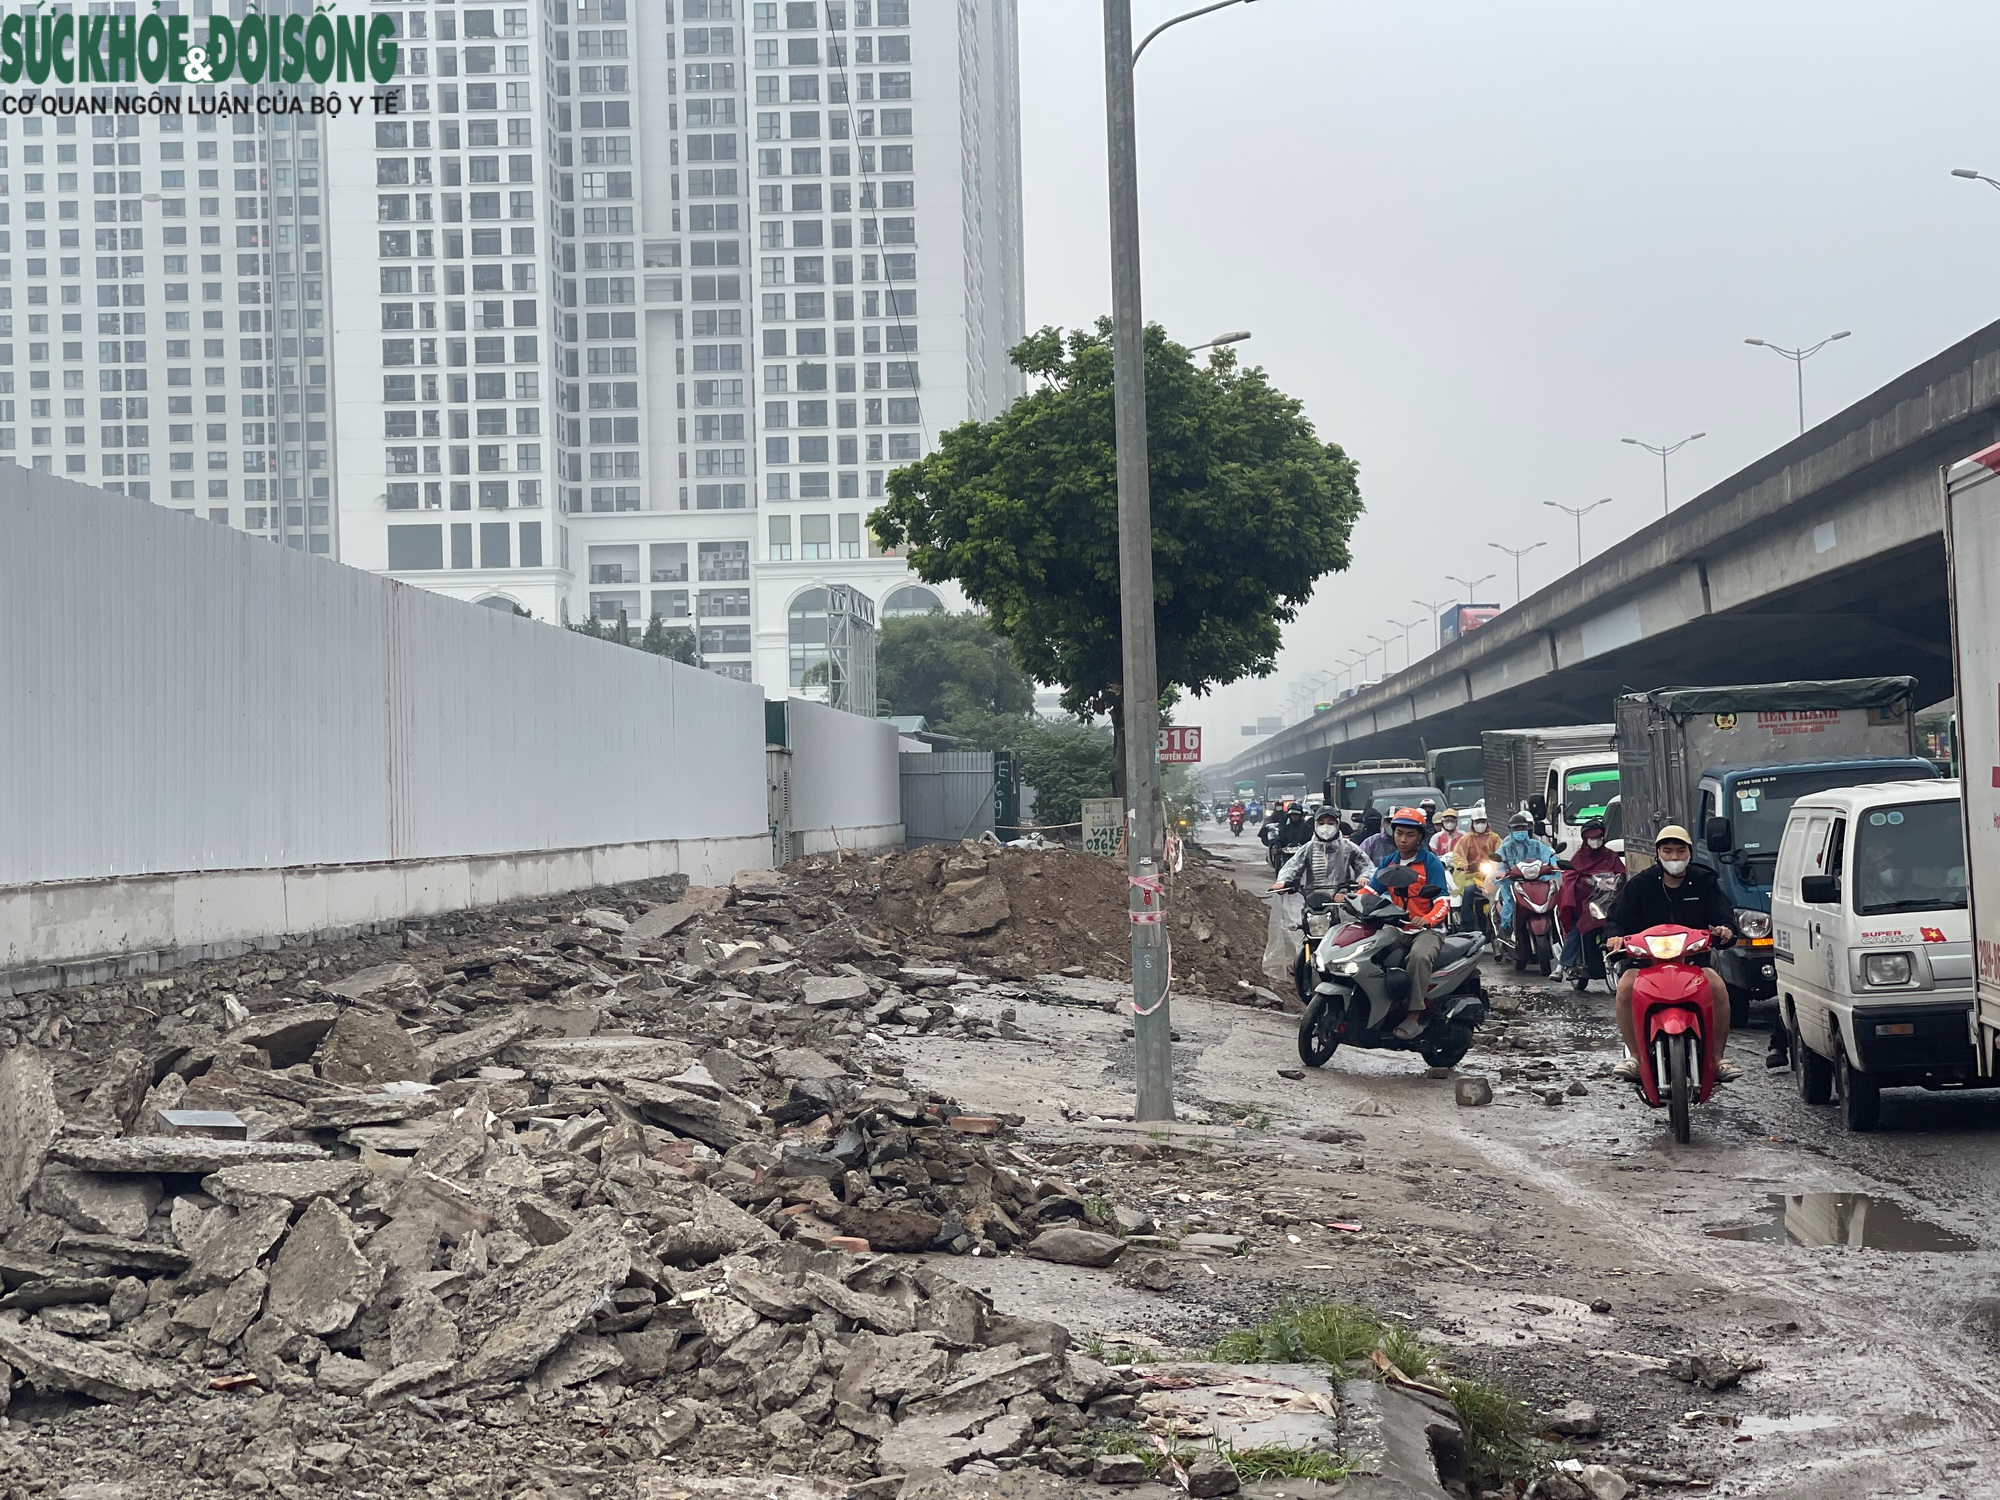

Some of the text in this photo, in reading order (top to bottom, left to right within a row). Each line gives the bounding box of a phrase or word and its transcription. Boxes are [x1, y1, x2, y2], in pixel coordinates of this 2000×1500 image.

[1158, 729, 1199, 751] 316
[1861, 930, 1902, 938] SUPER
[1861, 935, 1914, 945] CARRY
